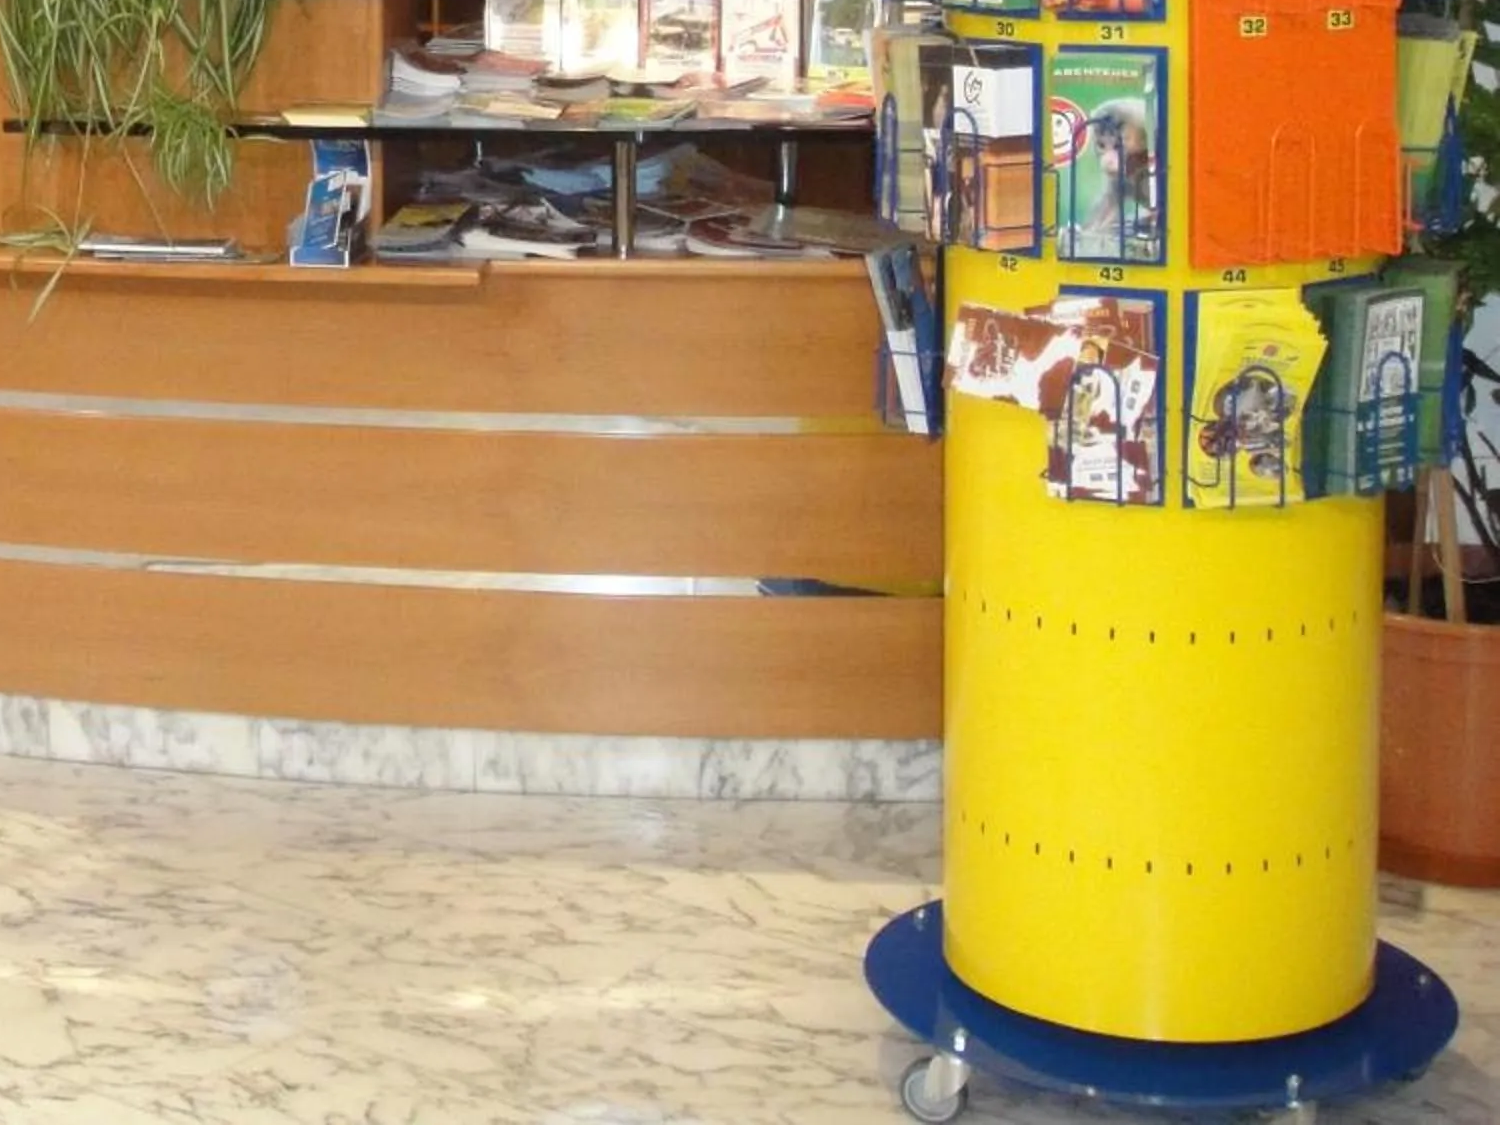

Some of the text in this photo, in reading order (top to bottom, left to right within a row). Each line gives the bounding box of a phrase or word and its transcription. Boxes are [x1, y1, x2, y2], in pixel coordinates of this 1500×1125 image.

[1330, 11, 1352, 26] 33
[996, 22, 1015, 36] 30
[1100, 26, 1124, 40] 31
[1242, 18, 1265, 34] 32
[1000, 256, 1018, 271] 42
[1329, 259, 1345, 273] 45
[1100, 267, 1124, 281] 43
[1222, 269, 1247, 283] 44
